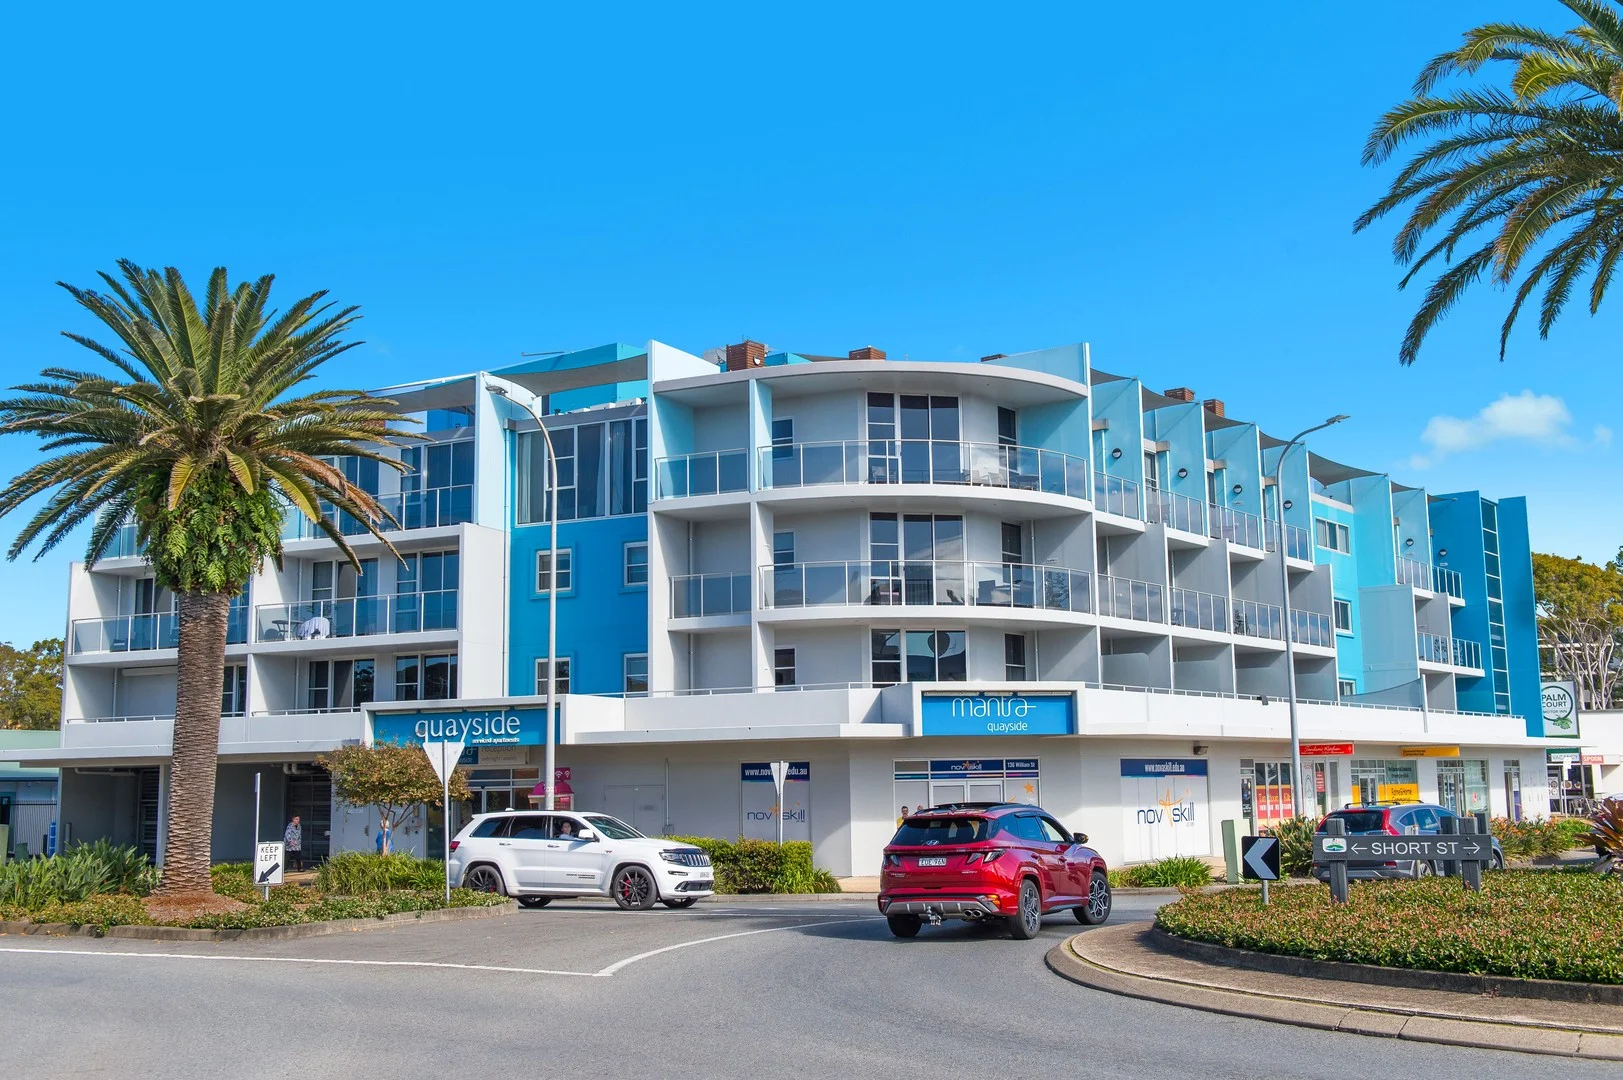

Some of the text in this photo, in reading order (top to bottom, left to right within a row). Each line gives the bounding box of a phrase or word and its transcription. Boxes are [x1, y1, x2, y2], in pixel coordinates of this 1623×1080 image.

[1542, 693, 1567, 701] PALM
[952, 697, 1037, 718] mantra
[414, 710, 520, 743] quayside
[987, 721, 1028, 733] quayside
[1371, 842, 1458, 854] SHORT ST
